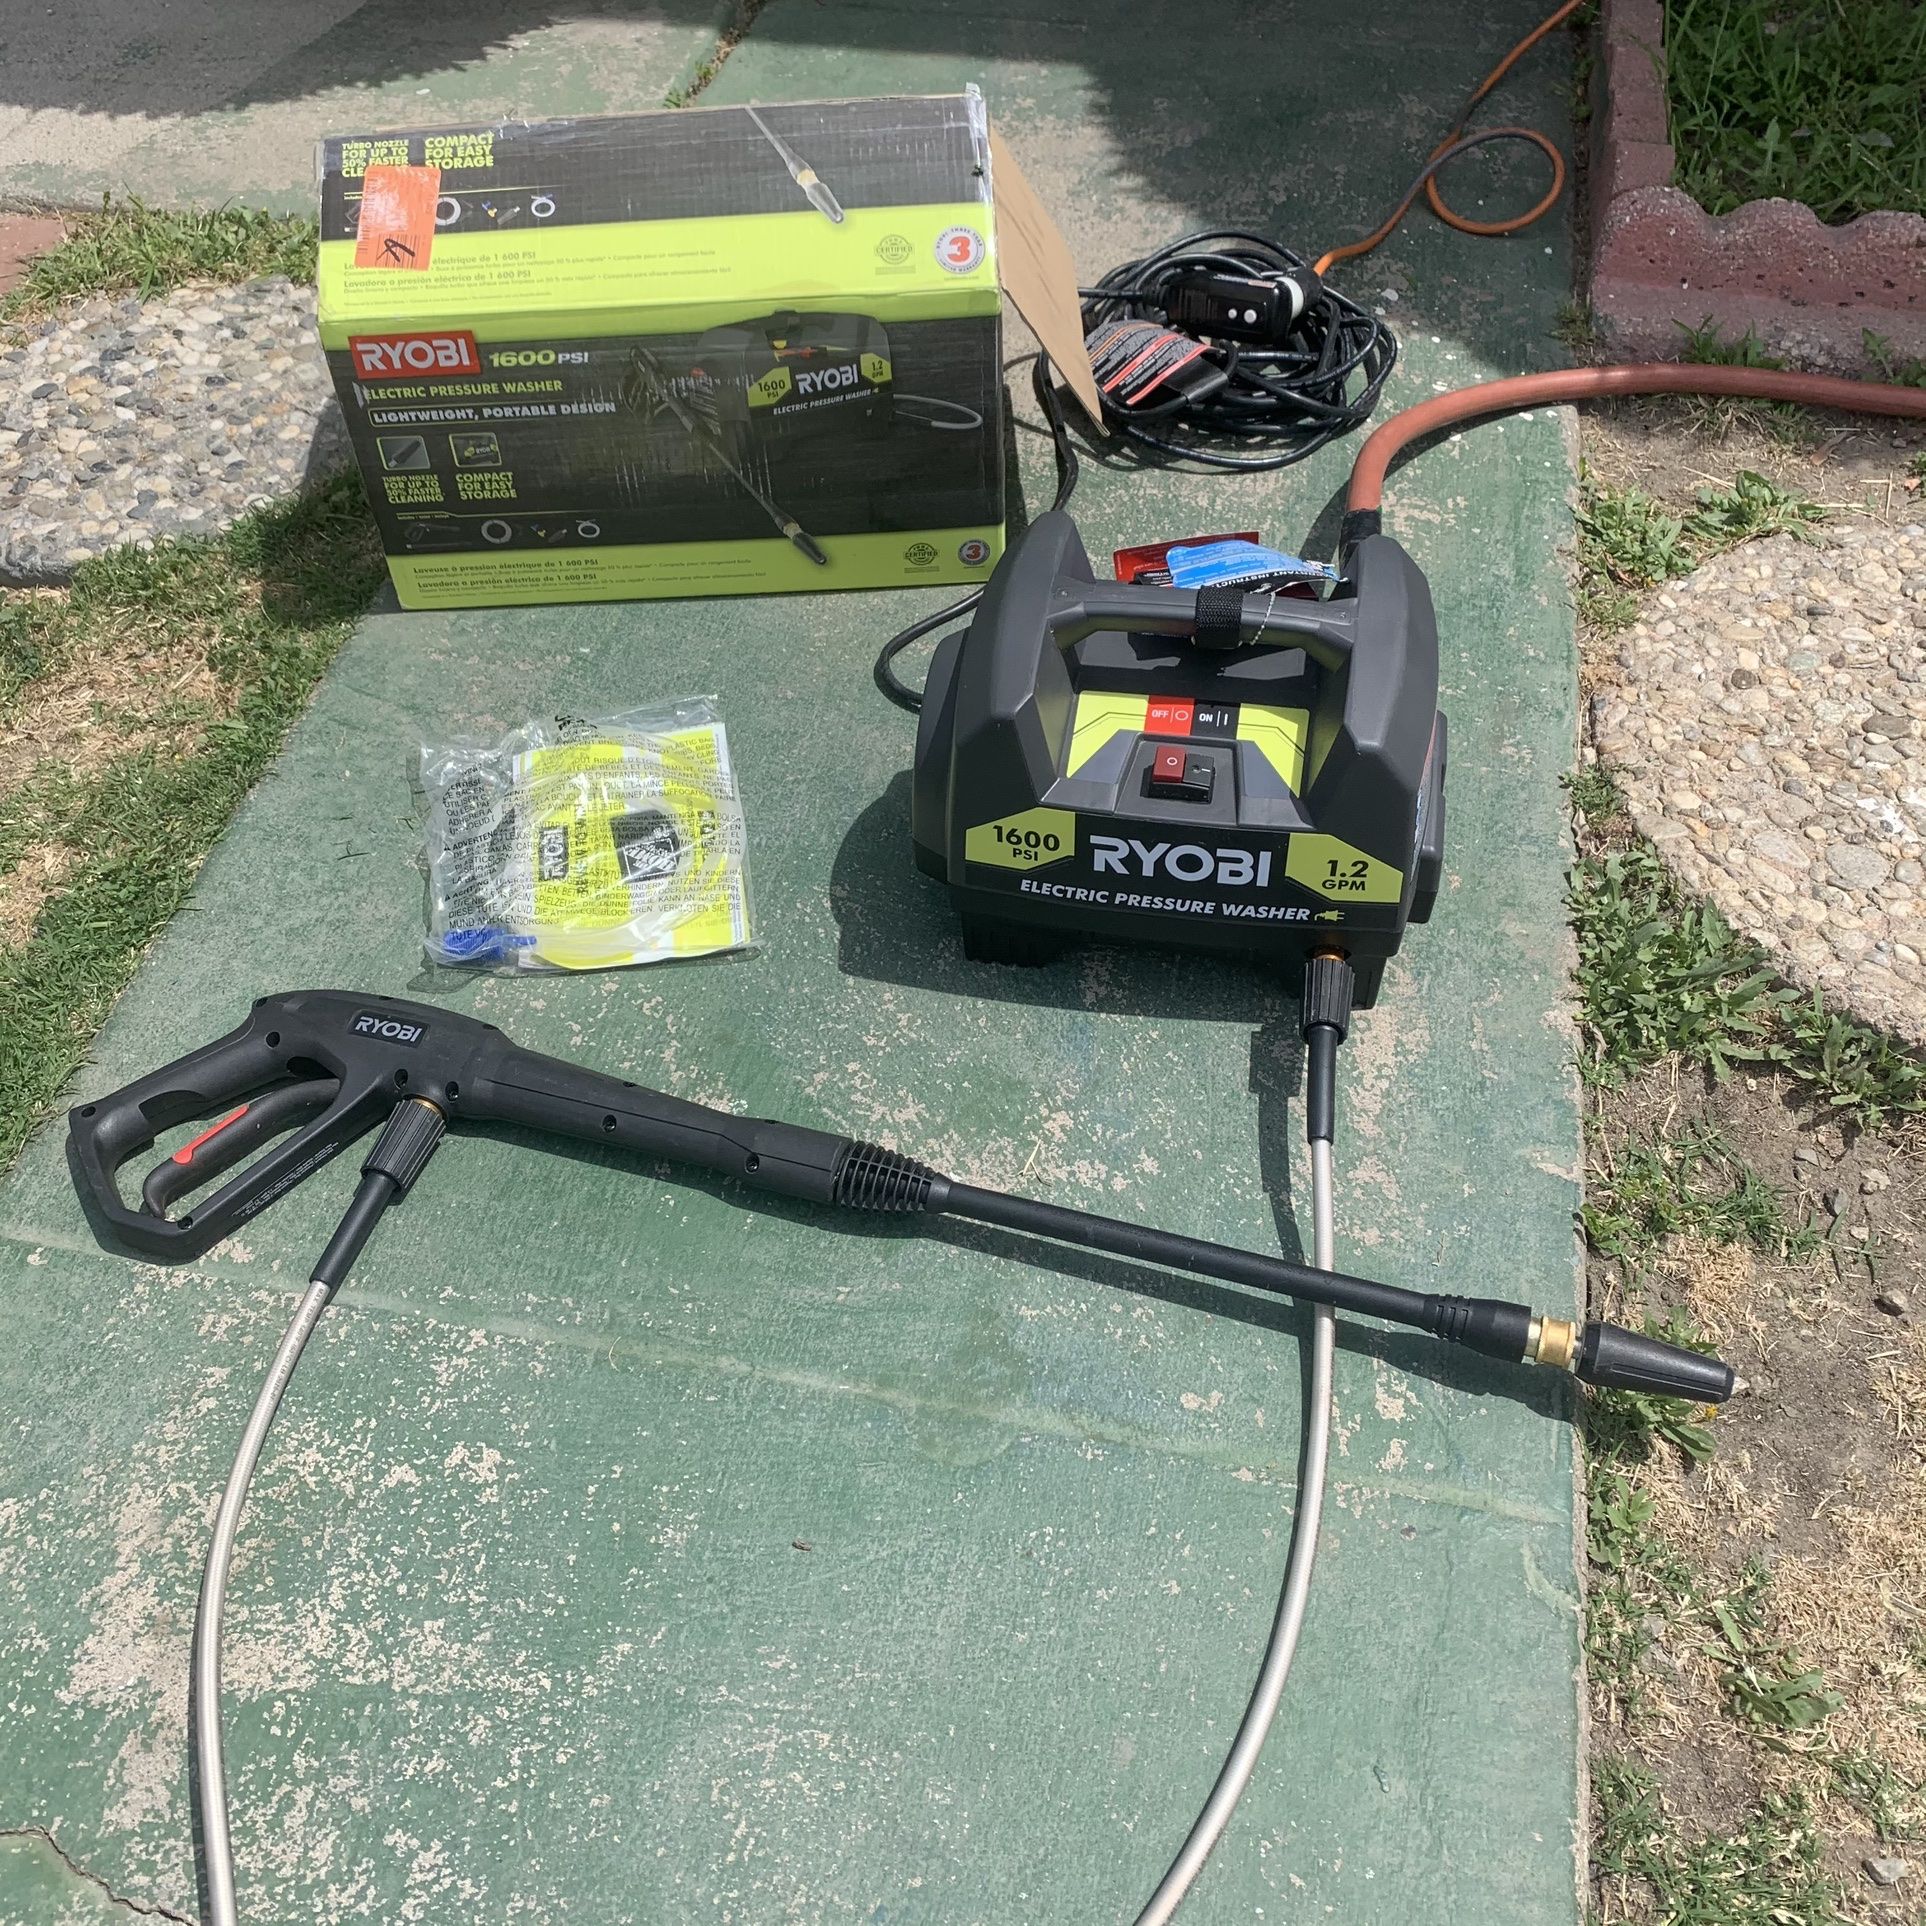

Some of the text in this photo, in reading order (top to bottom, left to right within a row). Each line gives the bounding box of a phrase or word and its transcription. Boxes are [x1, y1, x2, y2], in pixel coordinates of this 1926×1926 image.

[342, 139, 409, 150] TURBO NOZZLE
[424, 133, 495, 148] COMPACT
[342, 147, 408, 159] FOR UP TO
[424, 145, 492, 159] FOR EASY
[342, 156, 409, 168] 50% FASTER
[424, 155, 494, 170] STORAGE
[502, 252, 520, 261] 600
[522, 251, 536, 259] PSI
[946, 235, 971, 263] 3
[497, 270, 515, 279] 600
[517, 270, 531, 278] PSI
[356, 338, 471, 371] RYOBI
[489, 349, 588, 368] 1600 PSI
[758, 378, 786, 393] 1600
[795, 363, 859, 394] RYOBI
[366, 380, 563, 401] ELECTRIC PRESSURE WASHER
[767, 391, 779, 399] PSI
[773, 388, 871, 416] ELECTRIC PRESSURE WASHER
[373, 401, 616, 424] LIGHTWEIGHT, PORTABLE DESIGN
[456, 471, 513, 482] COMPACT
[384, 480, 439, 490] FOR UP TO
[408, 487, 441, 496] FASTER
[458, 480, 513, 491] FOR EASY
[460, 489, 517, 500] STORAGE
[965, 544, 982, 560] 3
[1151, 709, 1169, 718] OFF
[1199, 713, 1213, 722] ON
[993, 825, 1060, 852] 1600
[1012, 847, 1039, 861] PSI
[1089, 834, 1272, 888] RYOBI
[1327, 859, 1369, 878] 1.2
[1321, 879, 1367, 891] GPM
[1020, 878, 1311, 921] ELECTRIC PRESSURE WASHER
[354, 1015, 423, 1043] RYOBI
